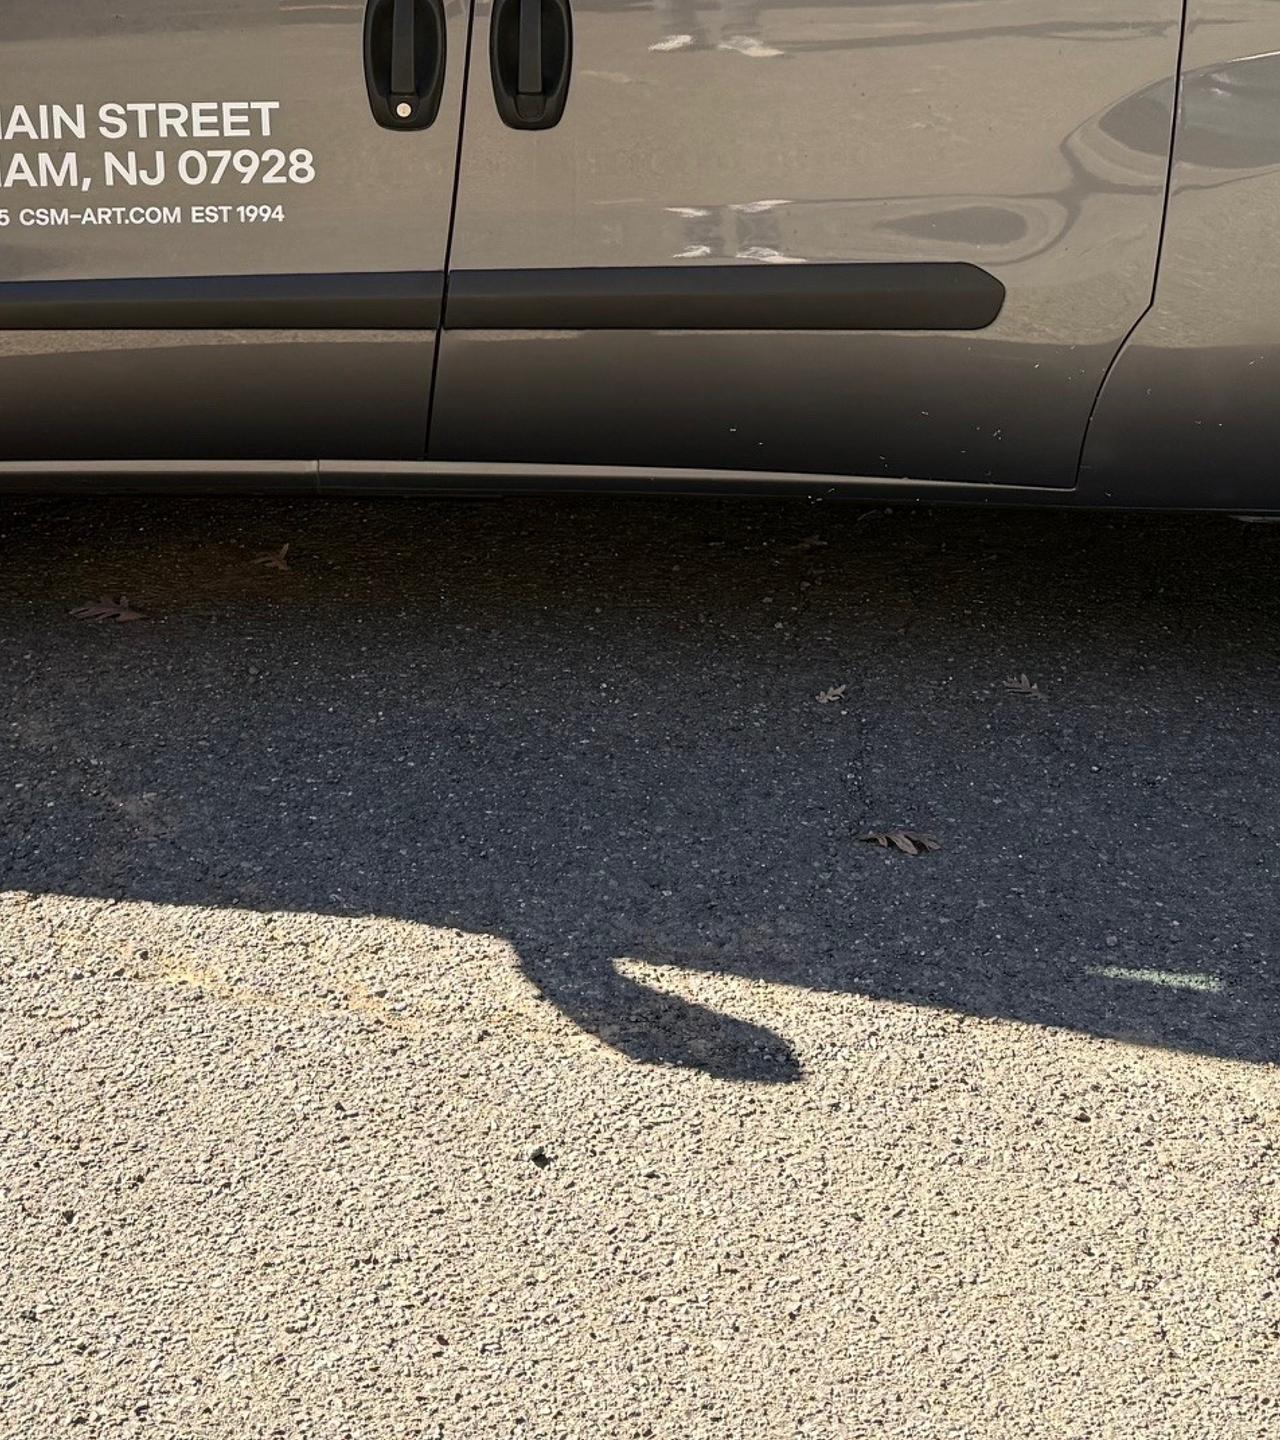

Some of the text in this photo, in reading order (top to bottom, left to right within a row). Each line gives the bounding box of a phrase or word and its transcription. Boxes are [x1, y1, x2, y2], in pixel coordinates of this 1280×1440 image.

[98, 101, 280, 138] STREET
[105, 150, 166, 187] NJ
[177, 148, 316, 186] 07928
[19, 206, 181, 226] CSM-ART.COM
[190, 206, 231, 223] EST
[236, 204, 285, 223] 1994
